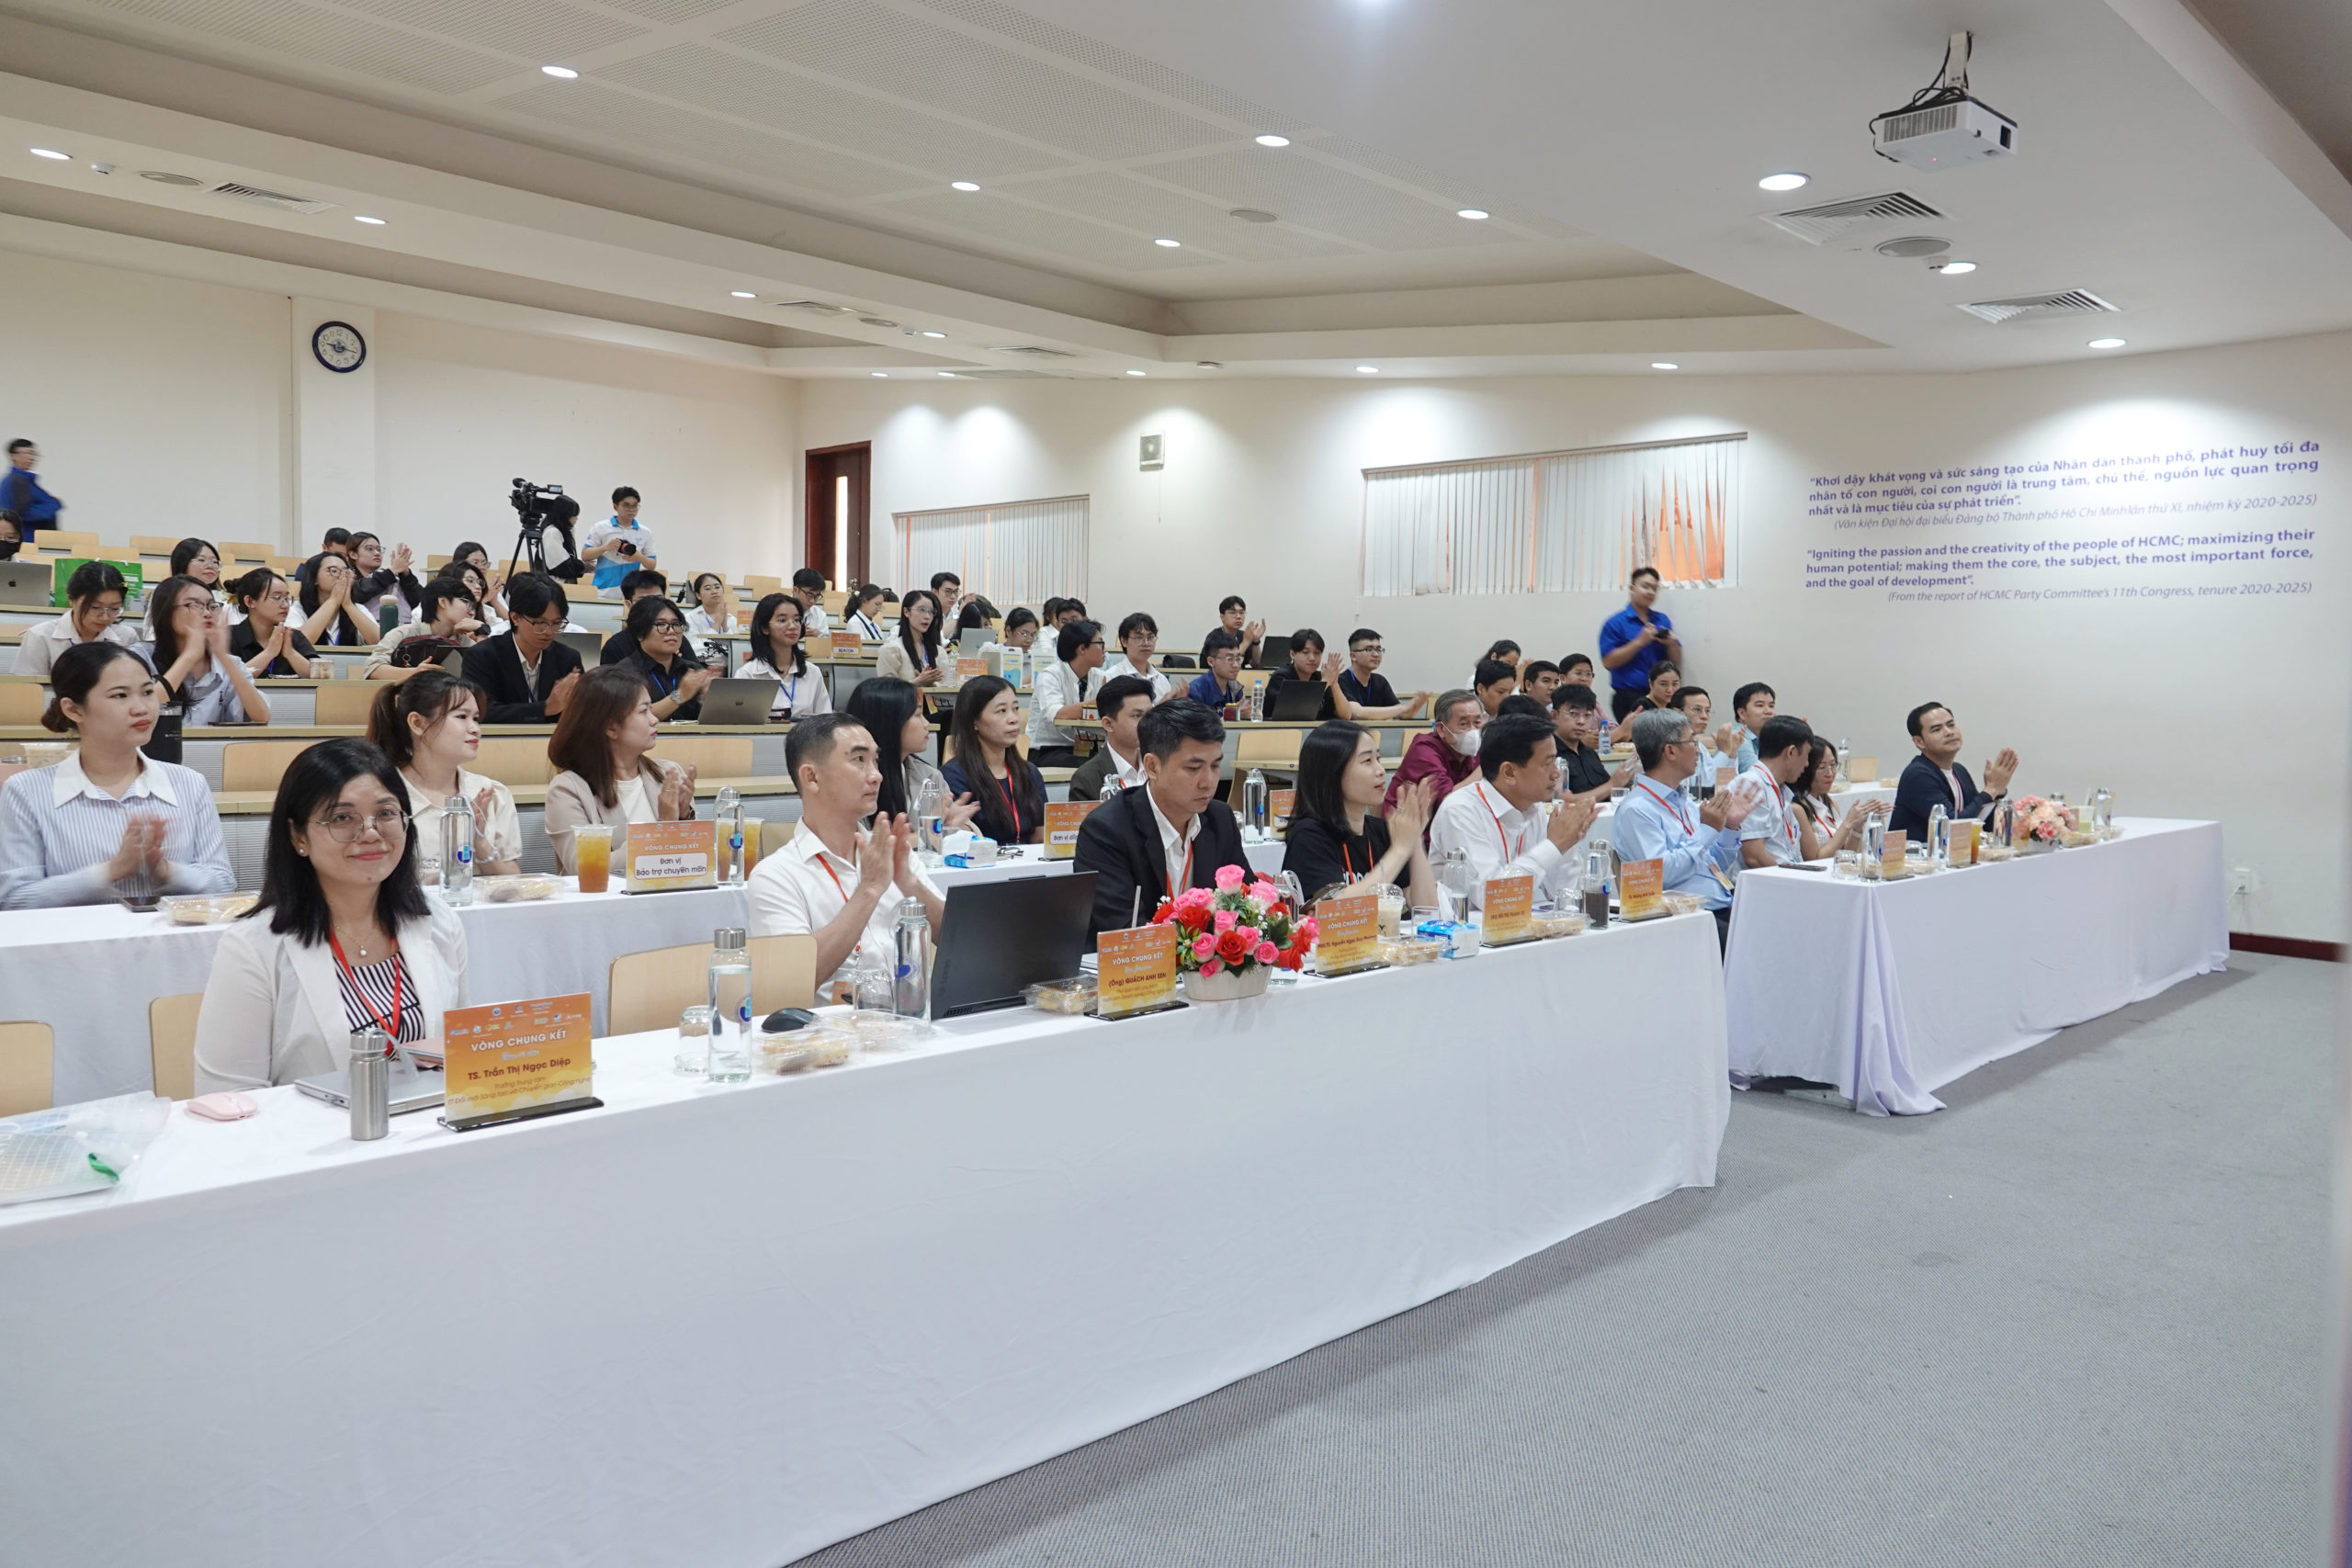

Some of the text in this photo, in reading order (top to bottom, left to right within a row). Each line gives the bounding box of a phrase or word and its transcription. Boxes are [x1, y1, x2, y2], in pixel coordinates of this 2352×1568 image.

[1844, 475, 1865, 487] dậy
[1870, 473, 1894, 482] khát
[1899, 472, 1926, 483] vọng
[1930, 468, 1943, 479] và
[1948, 468, 1966, 479] sức
[1970, 466, 1999, 478] sáng
[2005, 464, 2024, 475] tạo
[2028, 460, 2049, 472] của
[2053, 459, 2086, 470] Nhân
[2092, 457, 2116, 468] dân
[2120, 454, 2160, 466] thành
[2165, 448, 2195, 465] phố,
[2200, 447, 2234, 463] phát
[2240, 446, 2267, 458] huy
[2274, 441, 2293, 454] tối
[2300, 441, 2320, 452] đa
[1810, 491, 1836, 502] nhân
[1841, 488, 1853, 499] tố
[1883, 486, 1917, 499] người,
[1921, 485, 1937, 495] coi
[1966, 480, 2001, 494] người
[2007, 478, 2018, 490] là
[2022, 478, 2056, 490] trung
[2062, 476, 2090, 486] tâm,
[2096, 472, 2118, 484] chủ
[2204, 466, 2225, 479] lực
[2231, 465, 2268, 477] quan
[2275, 460, 2319, 474] trọng
[1809, 504, 1833, 516] nhất
[1837, 504, 1849, 513] và
[1852, 503, 1861, 513] là
[1865, 504, 1889, 514] mục
[1892, 502, 1913, 511] tiêu
[1917, 500, 1935, 510] của
[1939, 501, 1951, 512] sự
[1954, 497, 1982, 510] phát
[2244, 494, 2317, 509] 2020-2025)
[1859, 547, 1878, 558] the
[1881, 547, 1922, 559] passion
[1925, 545, 1947, 556] and
[1950, 544, 1968, 555] the
[1972, 542, 2030, 555] creativity
[2032, 541, 2047, 553] of
[2049, 540, 2070, 552] the
[2073, 538, 2118, 552] people
[2121, 536, 2135, 547] of
[2138, 535, 2185, 547] HCMC;
[2188, 532, 2273, 546] maximizing
[2278, 529, 2315, 541] their
[1806, 547, 2313, 574] human potential; making them the core, the subject, the most important force,
[1805, 578, 1826, 588] and
[1828, 578, 1847, 588] the
[1849, 576, 1874, 589] goal
[1878, 576, 1889, 586] of
[1888, 592, 1916, 602] (From
[1917, 591, 1933, 601] the
[1934, 591, 1965, 602] report
[1967, 589, 1978, 601] of
[1979, 590, 2012, 599] HCMC
[2014, 589, 2041, 601] Party
[2113, 587, 2137, 597] 11th
[2140, 585, 2195, 599] Congress,
[2198, 584, 2237, 595] tenure
[2240, 581, 2312, 594] 2020-2025)
[1132, 953, 1152, 962] CHUNG
[1109, 978, 1124, 987] (Ông)
[1125, 975, 1144, 984] QUÁCH
[471, 1028, 567, 1052] VÒNG CHUNG KẾT
[469, 1058, 571, 1080] TS. Trần Thị Ngọc Diệp
